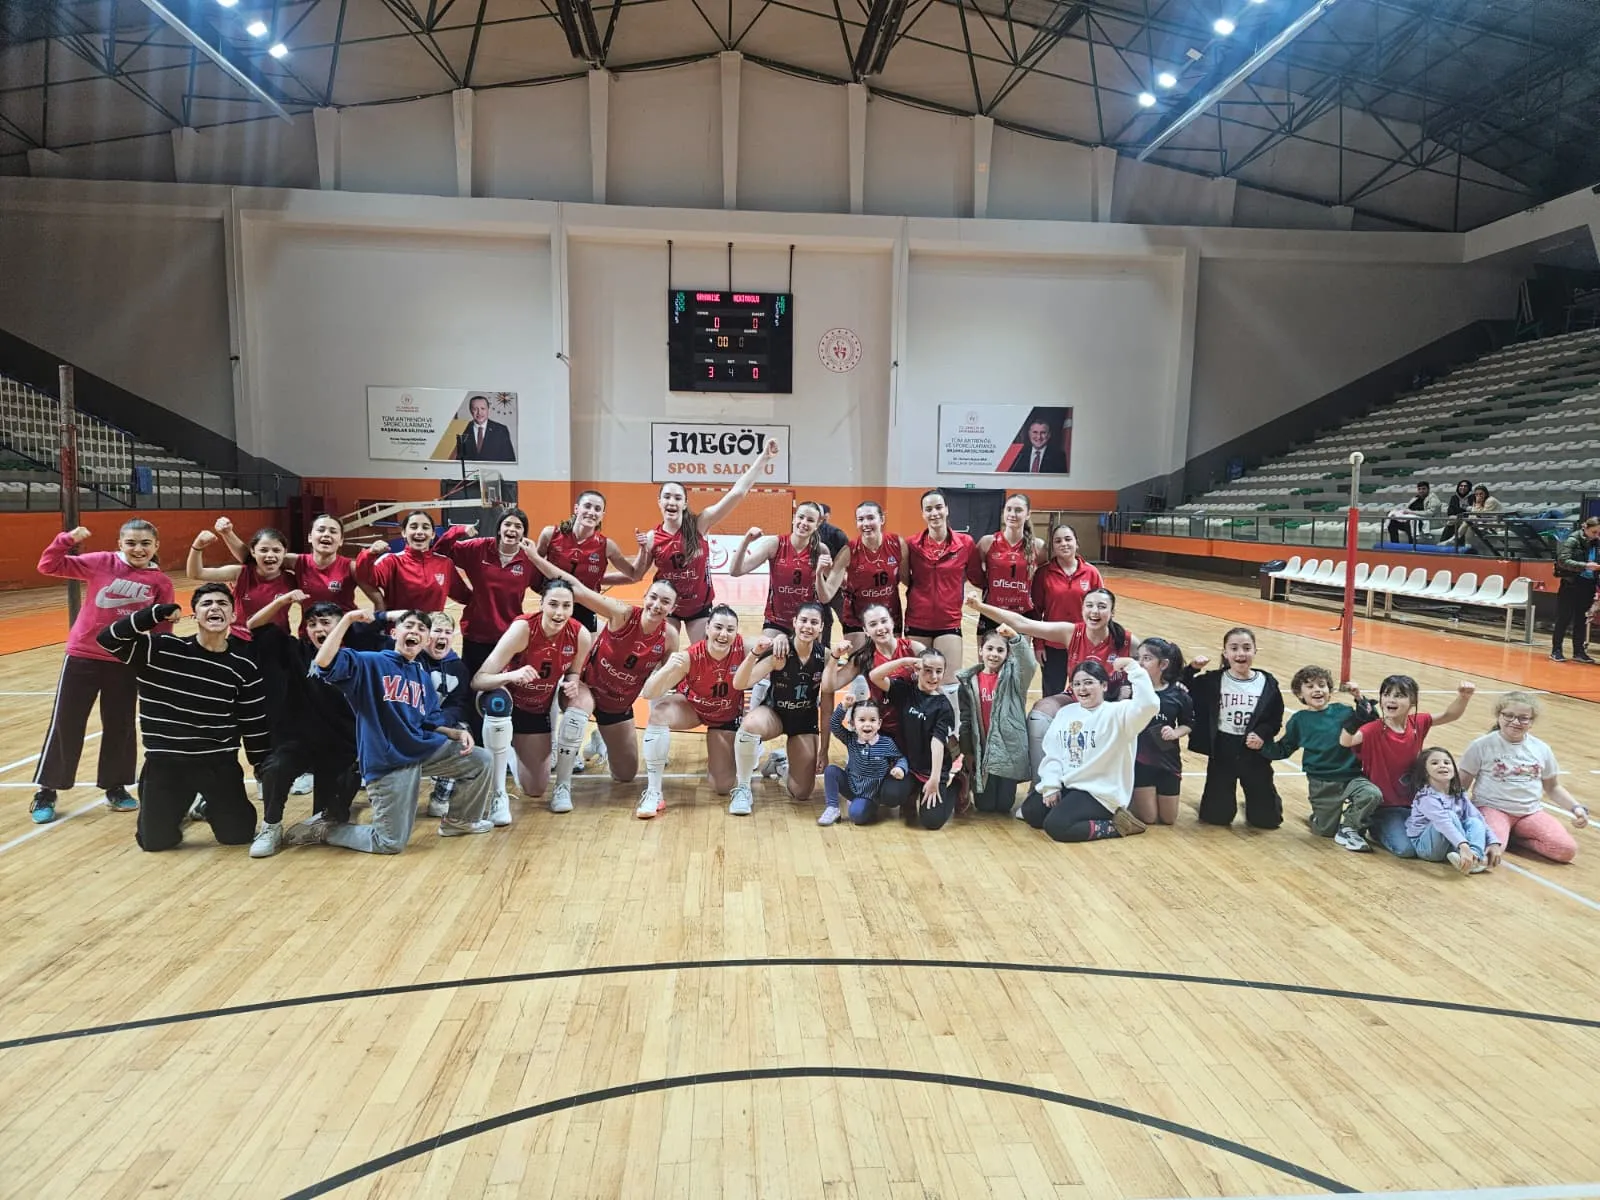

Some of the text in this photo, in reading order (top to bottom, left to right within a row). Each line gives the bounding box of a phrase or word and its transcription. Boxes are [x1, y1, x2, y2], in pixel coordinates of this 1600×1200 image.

[714, 317, 720, 328] 0
[752, 318, 758, 329] 0
[708, 366, 714, 378] 3
[728, 367, 734, 377] 4
[752, 367, 759, 379] 0
[668, 462, 774, 475] SPOR SALOU
[106, 578, 151, 598] NIKE
[539, 661, 552, 679] 5
[711, 681, 728, 697] 10
